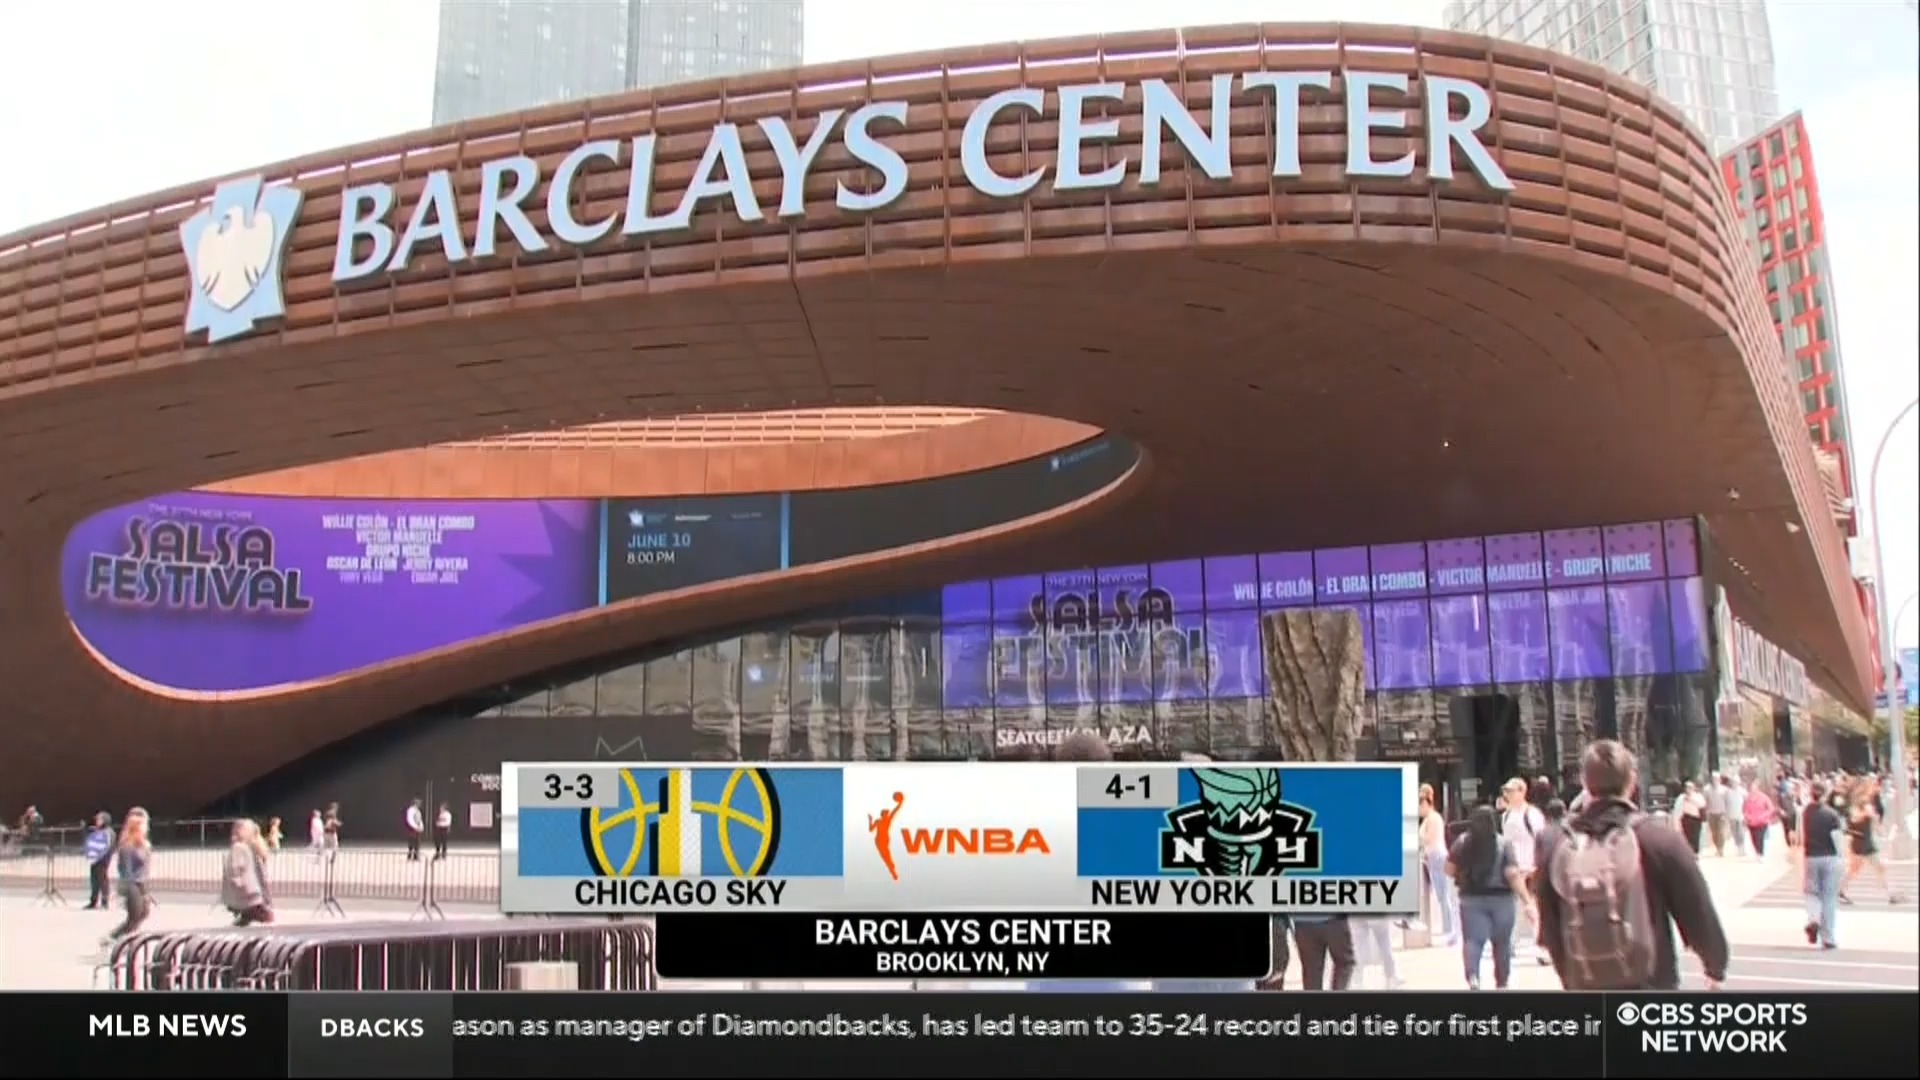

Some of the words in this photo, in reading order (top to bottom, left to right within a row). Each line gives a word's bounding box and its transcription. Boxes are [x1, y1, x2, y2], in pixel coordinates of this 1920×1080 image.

[333, 101, 911, 283] BARCLAYS
[959, 70, 1515, 198] CENTER
[127, 516, 275, 570] SALSA
[627, 533, 667, 549] JUNE
[672, 533, 691, 547] 10
[656, 551, 675, 563] PM
[86, 551, 314, 613] FESTIVAL
[1326, 574, 1340, 595] EL
[1379, 570, 1426, 591] COMBO
[1437, 566, 1484, 587] VICTOR
[1611, 553, 1652, 574] NICHE
[1030, 587, 1175, 636] SALSA
